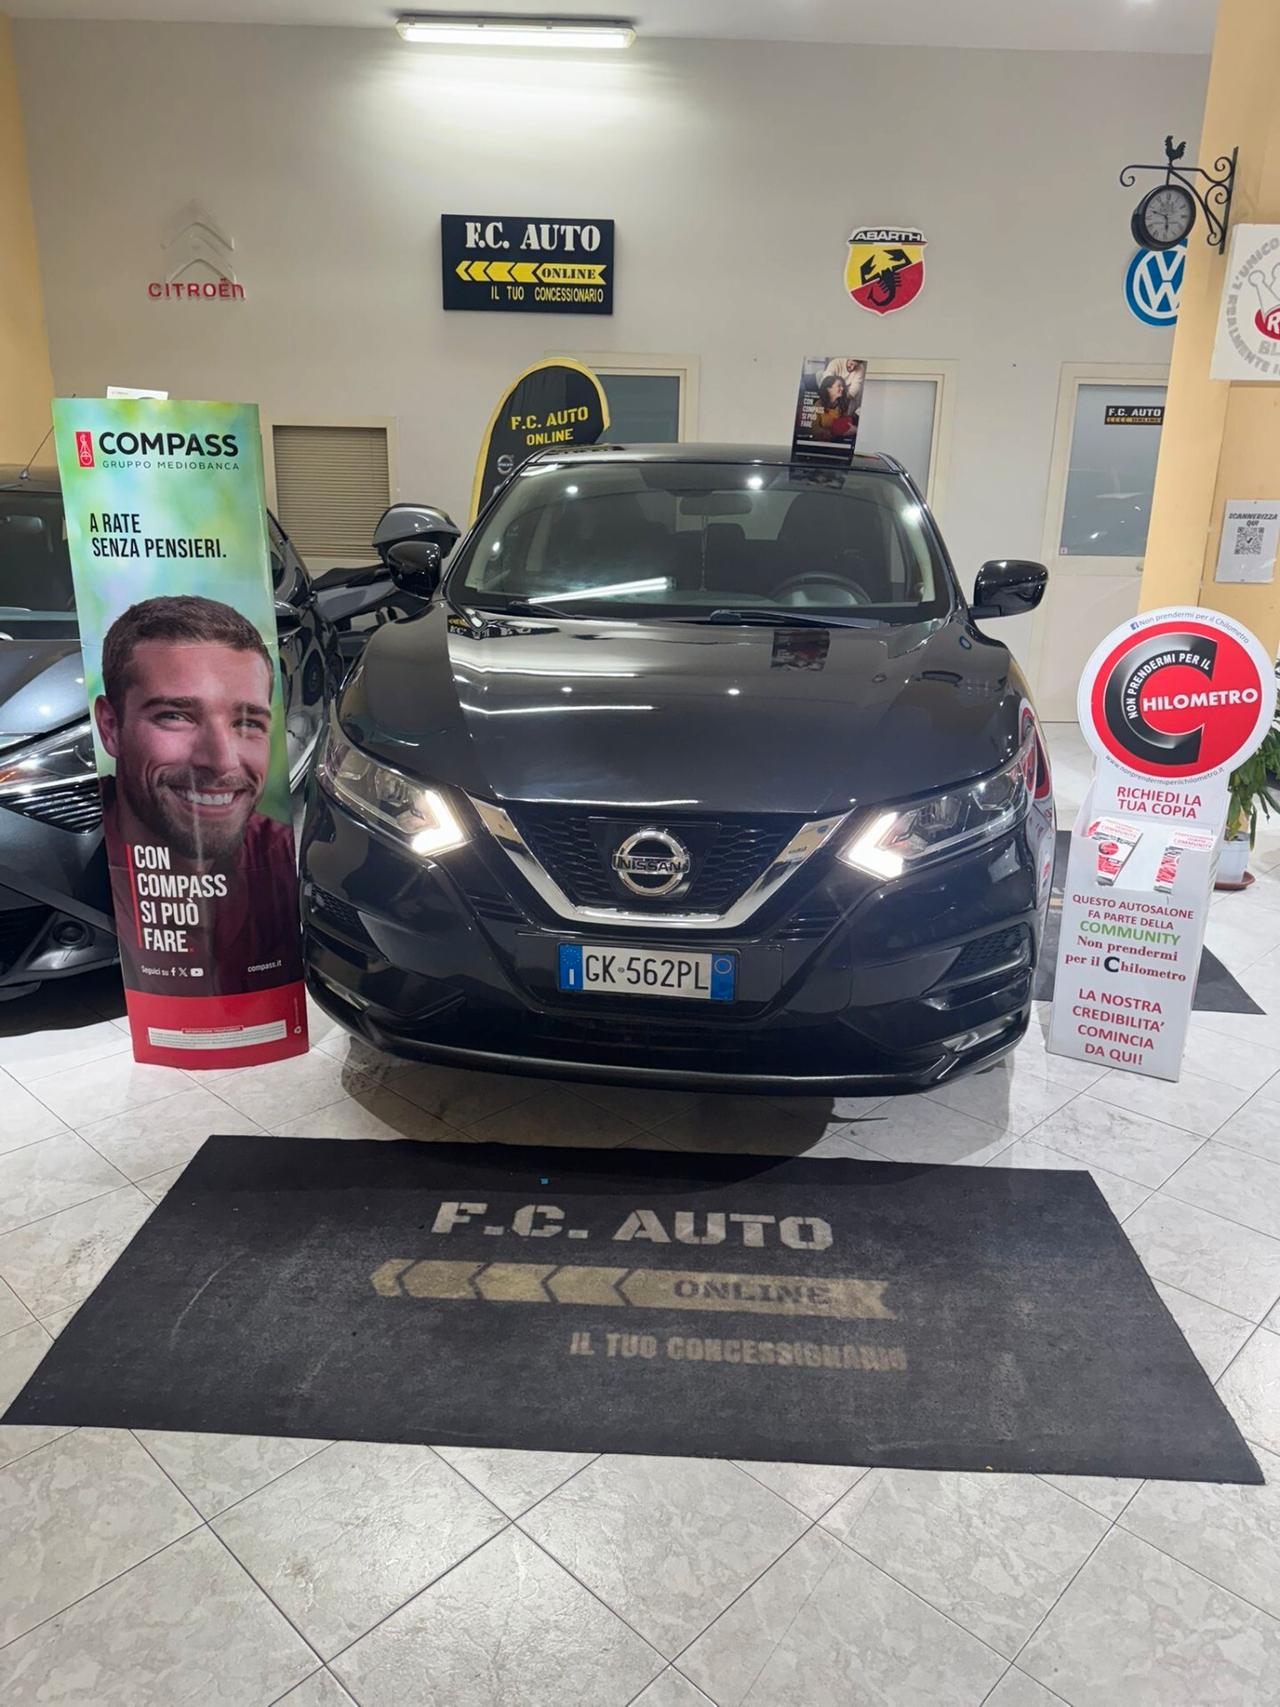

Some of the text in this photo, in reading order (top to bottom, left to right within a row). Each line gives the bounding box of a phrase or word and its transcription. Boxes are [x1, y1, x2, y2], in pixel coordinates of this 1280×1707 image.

[465, 221, 601, 251] F.C. AUTO
[854, 231, 921, 241] ABARTH
[541, 267, 596, 280] ONLINE
[491, 286, 604, 303] IL TUO CONCESSIONARIO
[511, 406, 589, 430] F.C. AUTO
[1108, 408, 1161, 416] F.C. AUTO
[99, 431, 239, 457] COMPASS
[526, 428, 574, 446] ONLINE
[102, 460, 240, 471] GRUPPO MEDIOBANCA
[90, 513, 142, 533] A RATE
[92, 537, 227, 558] SENZA PENSIERI.
[1139, 616, 1155, 626] Non
[1156, 611, 1194, 622] prendermi
[1196, 612, 1209, 621] per
[1215, 616, 1250, 644] Chilometro
[1126, 652, 1212, 719] NON PRENDERMI PER IL
[1117, 786, 1202, 807] RICHIEDI LA
[1118, 799, 1197, 819] TUA COPIA
[134, 845, 171, 870] CON
[618, 857, 683, 872] NISSAN
[137, 873, 228, 898] COMPASS
[140, 898, 199, 926] SI PUÒ
[1072, 894, 1195, 920] QUESTO AUTOSALONE
[1088, 909, 1174, 930] FA PARTE DELLA
[1079, 920, 1181, 946] COMMUNITY
[1077, 935, 1178, 961] Non prendermi
[247, 960, 282, 973] compass.it
[1065, 953, 1187, 982] per il Chilometro
[1079, 988, 1162, 1014] LA NOSTRA
[1078, 1024, 1154, 1049] COMINCIA
[1085, 1042, 1143, 1065] DA QUI!
[431, 1202, 833, 1250] F.C. AUTO
[673, 1279, 830, 1305] ONLINE
[569, 1331, 595, 1356] IL
[606, 1332, 658, 1359] TUO
